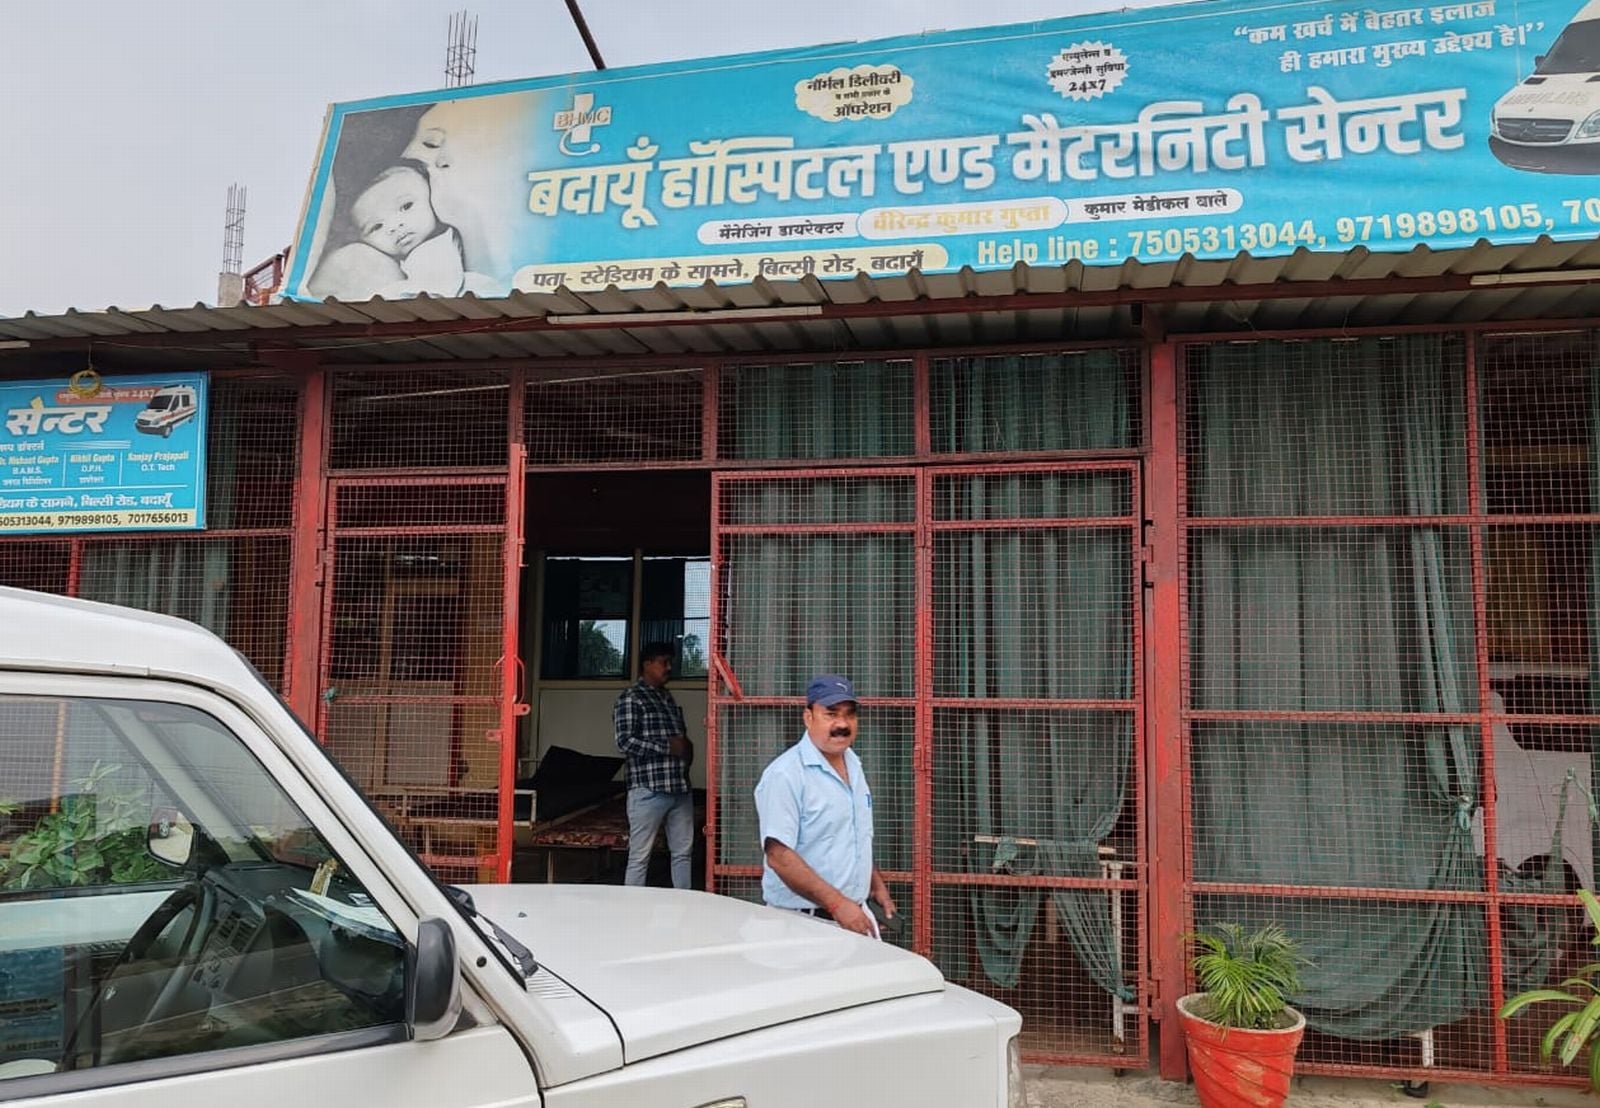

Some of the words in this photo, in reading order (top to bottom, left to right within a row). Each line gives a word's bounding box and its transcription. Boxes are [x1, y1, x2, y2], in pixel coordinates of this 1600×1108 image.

[1292, 14, 1334, 39] खर्च
[1339, 12, 1359, 32] में
[1364, 9, 1424, 30] बेहतर
[1429, 0, 1496, 24] इलाज
[1278, 51, 1301, 72] ही
[1307, 47, 1366, 69] हमारा
[1372, 40, 1426, 67] मुख्य
[1431, 31, 1494, 54] उद्देश्य
[807, 76, 844, 90] नॉर्मल
[556, 108, 612, 130] BHMC
[833, 101, 892, 117] ऑपरेशन
[528, 136, 659, 229] बदायूँ
[658, 136, 882, 209] हॉस्पिटल
[888, 134, 999, 195] एण्ड
[1007, 93, 1269, 184] मैटरनिटी
[1276, 86, 1468, 164] सेन्टर
[936, 207, 993, 231] कुमार
[999, 204, 1052, 228] गुप्ता
[1084, 200, 1127, 220] कुमार
[1132, 196, 1190, 214] मेडीकल
[1195, 190, 1229, 208] वाले
[778, 219, 845, 236] डायरेक्टर
[978, 238, 1038, 264] Help
[1048, 236, 1098, 260] line
[1128, 219, 1326, 256] 7505313044,
[1336, 202, 1555, 244] 9719898105,
[580, 265, 655, 285] स्टेडियम
[660, 261, 681, 280] के
[758, 256, 816, 277] बिल्सी
[58, 513, 122, 525] 9719898105,
[128, 512, 188, 524] 7017656013
